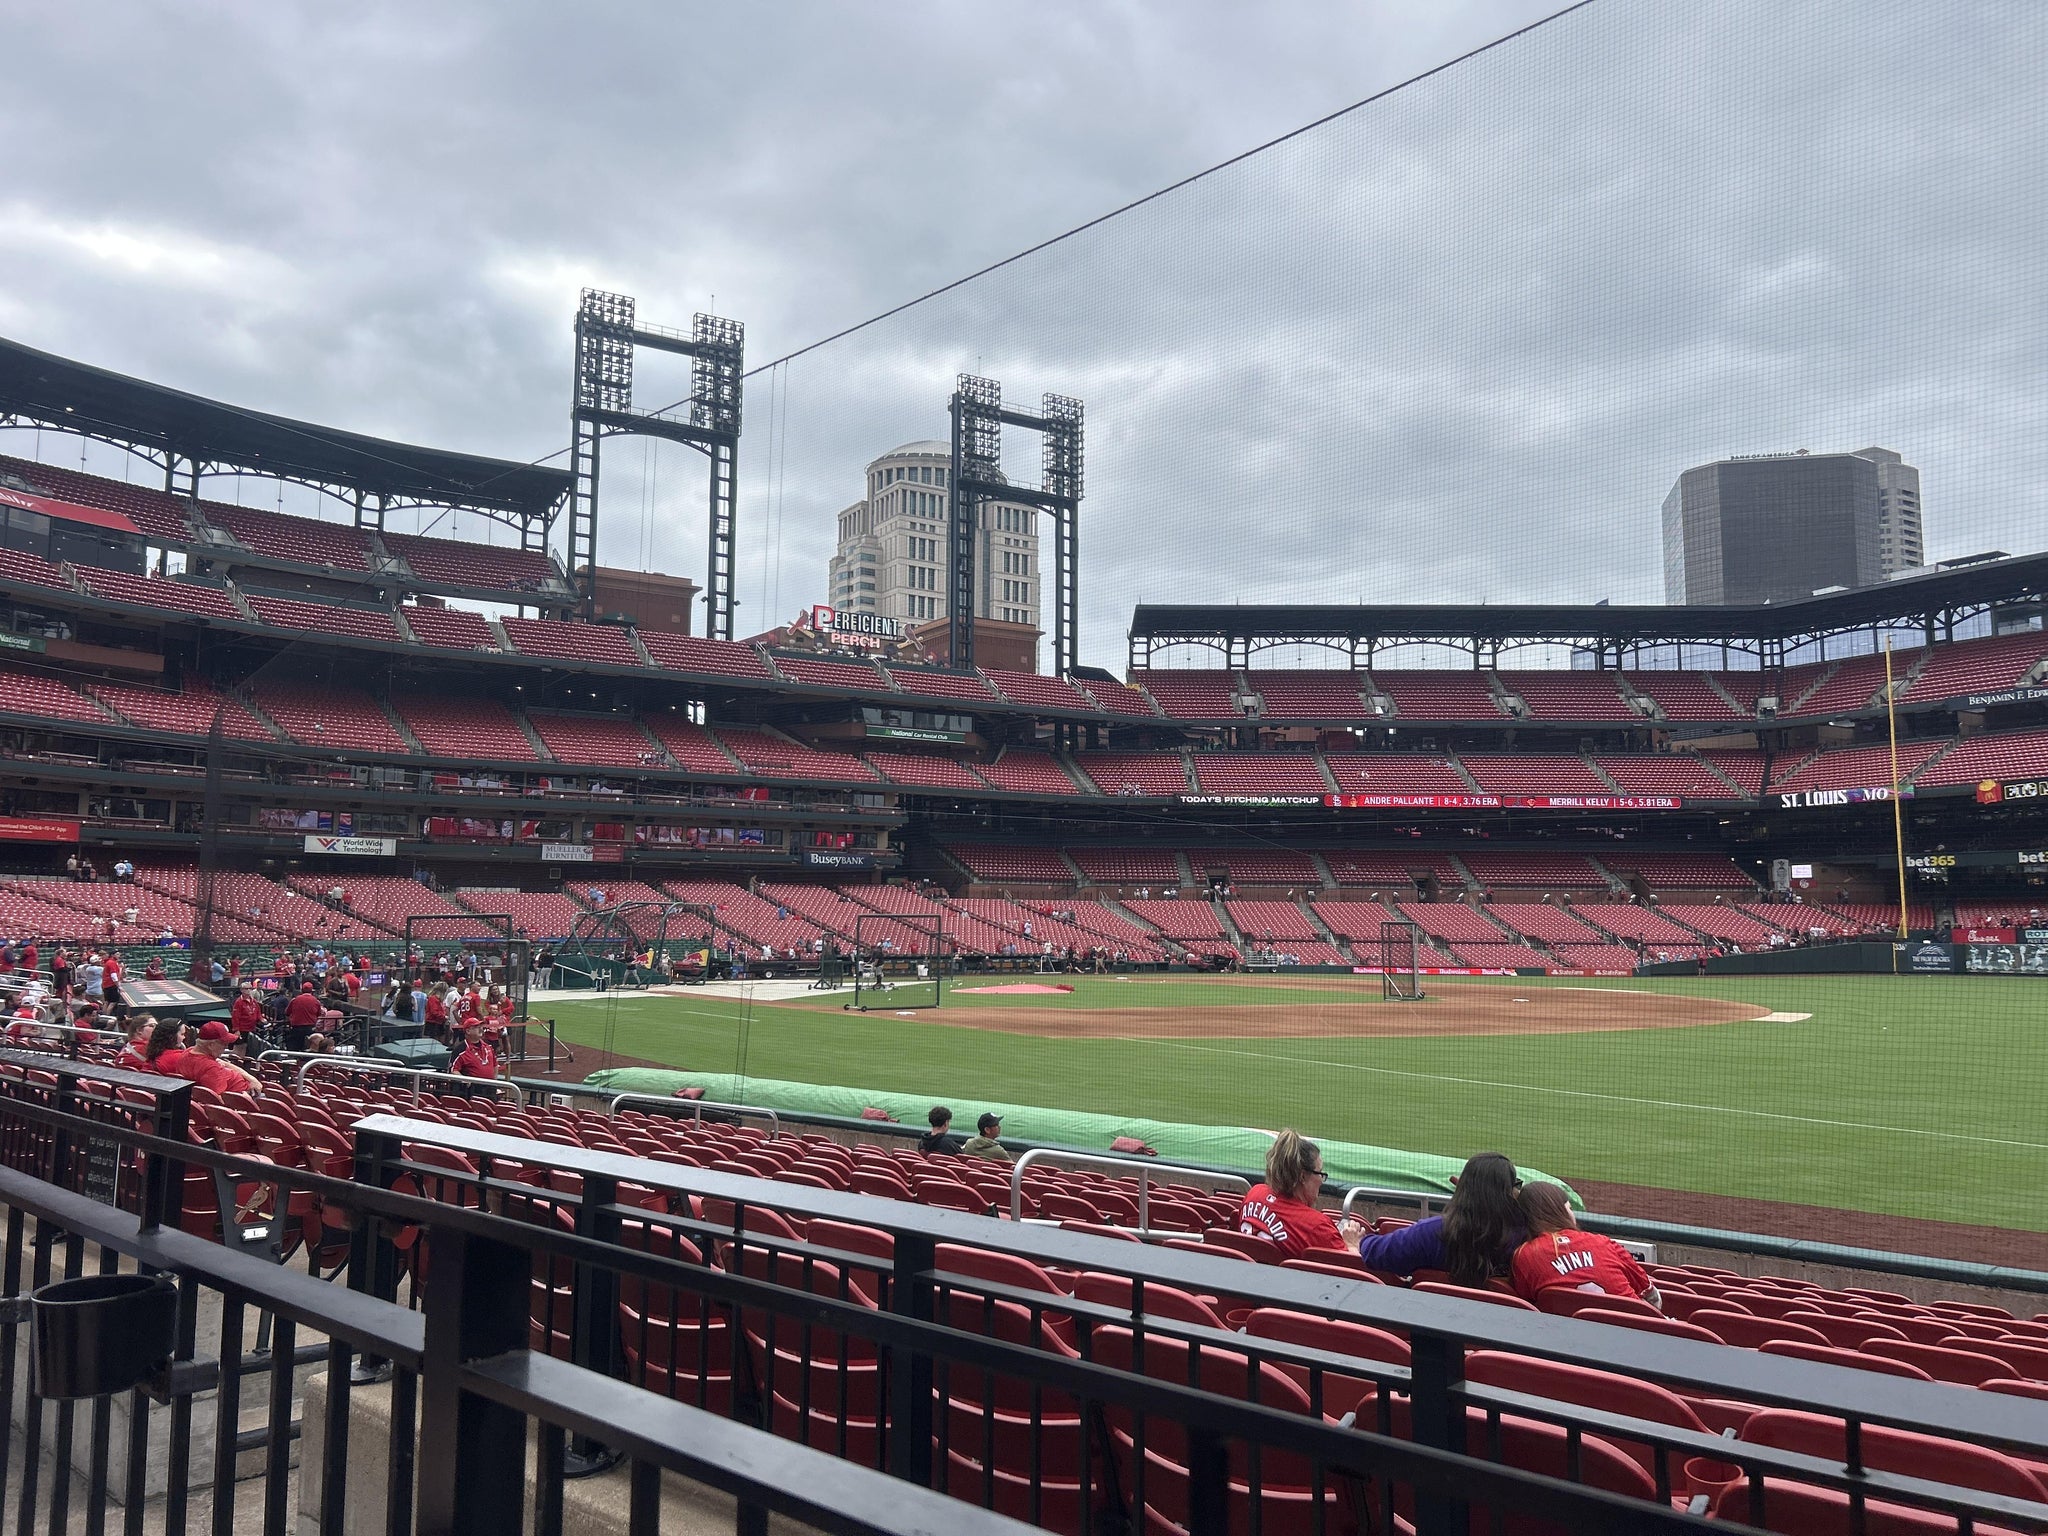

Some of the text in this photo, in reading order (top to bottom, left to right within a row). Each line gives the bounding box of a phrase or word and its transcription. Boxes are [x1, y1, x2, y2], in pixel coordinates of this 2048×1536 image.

[831, 632, 880, 649] PERCH
[1968, 693, 2015, 706] BENJAMIN
[891, 729, 913, 737] National
[1271, 796, 1319, 804] MATCHUP
[1364, 797, 1391, 805] ANDRE
[1393, 797, 1435, 805] PALLANTE
[1463, 797, 1481, 806] 3.76
[1482, 797, 1499, 806] ERA
[1550, 797, 1584, 806] MERRILL
[1585, 797, 1609, 806] KELLY
[1638, 797, 1656, 807] 5.81
[1656, 797, 1673, 807] ERA
[1781, 787, 1889, 808] ST. LOUIS MO
[343, 846, 383, 855] Technology
[545, 845, 582, 853] MUELLER
[545, 852, 591, 860] FURNITURE
[1905, 855, 1956, 867] bet365
[460, 1000, 471, 1012] 28
[1241, 1201, 1288, 1241] ARENADO
[1551, 1251, 1594, 1276] WINN
